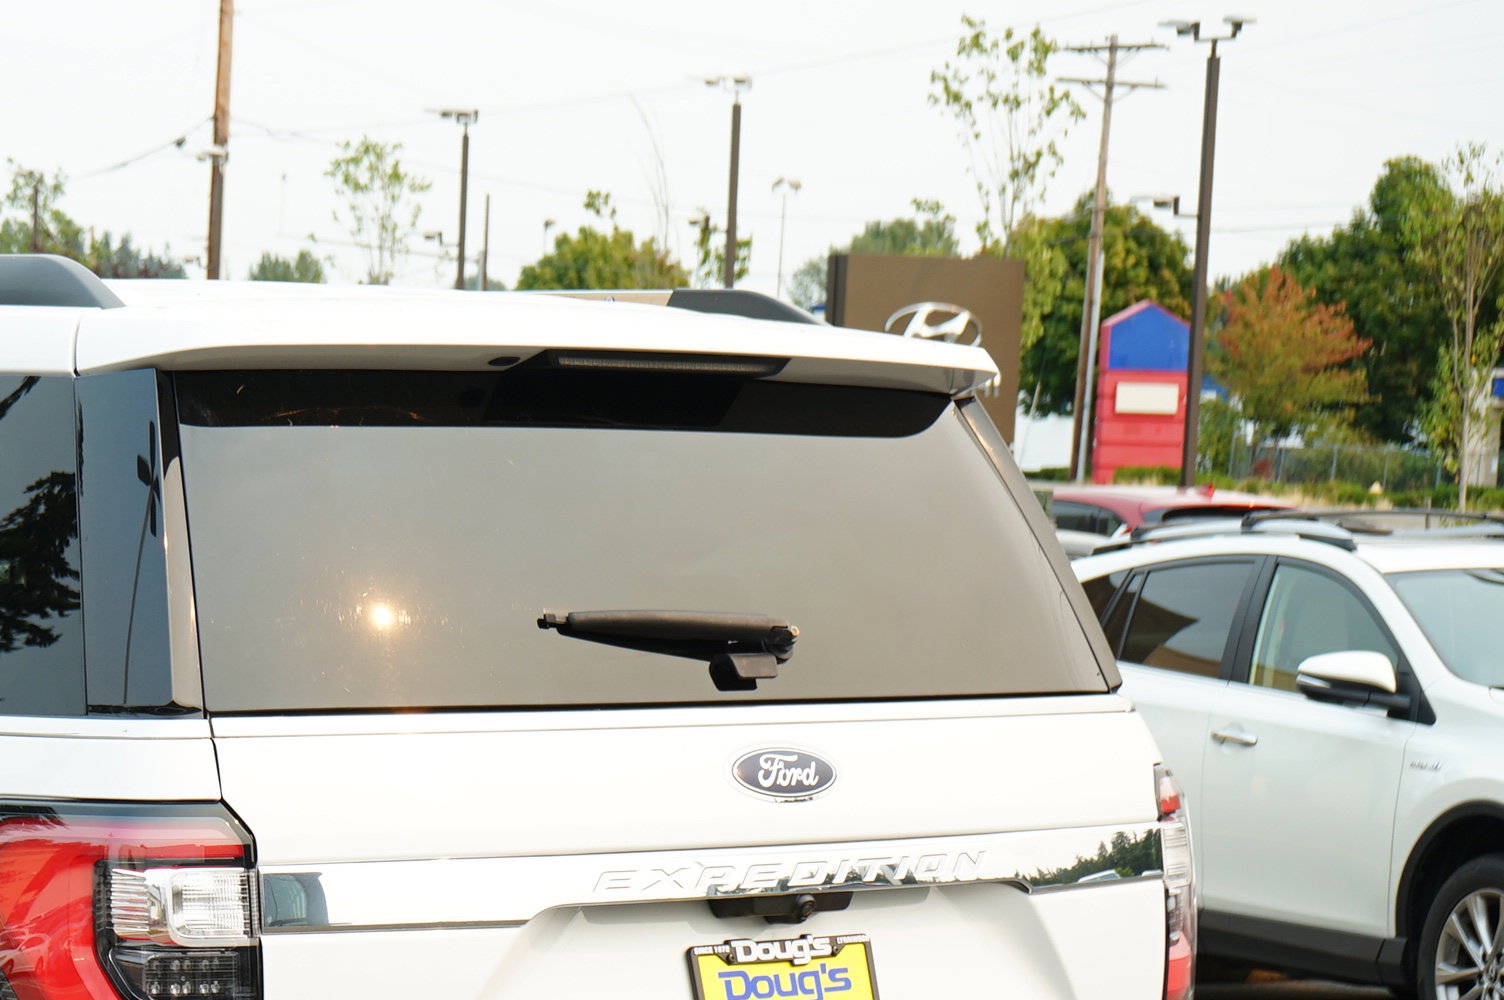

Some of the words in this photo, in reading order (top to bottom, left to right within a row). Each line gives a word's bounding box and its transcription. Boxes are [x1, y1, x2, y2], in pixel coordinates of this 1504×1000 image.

[758, 753, 818, 789] Ford
[593, 849, 989, 894] EXPEDITION
[730, 934, 833, 965] Doug's
